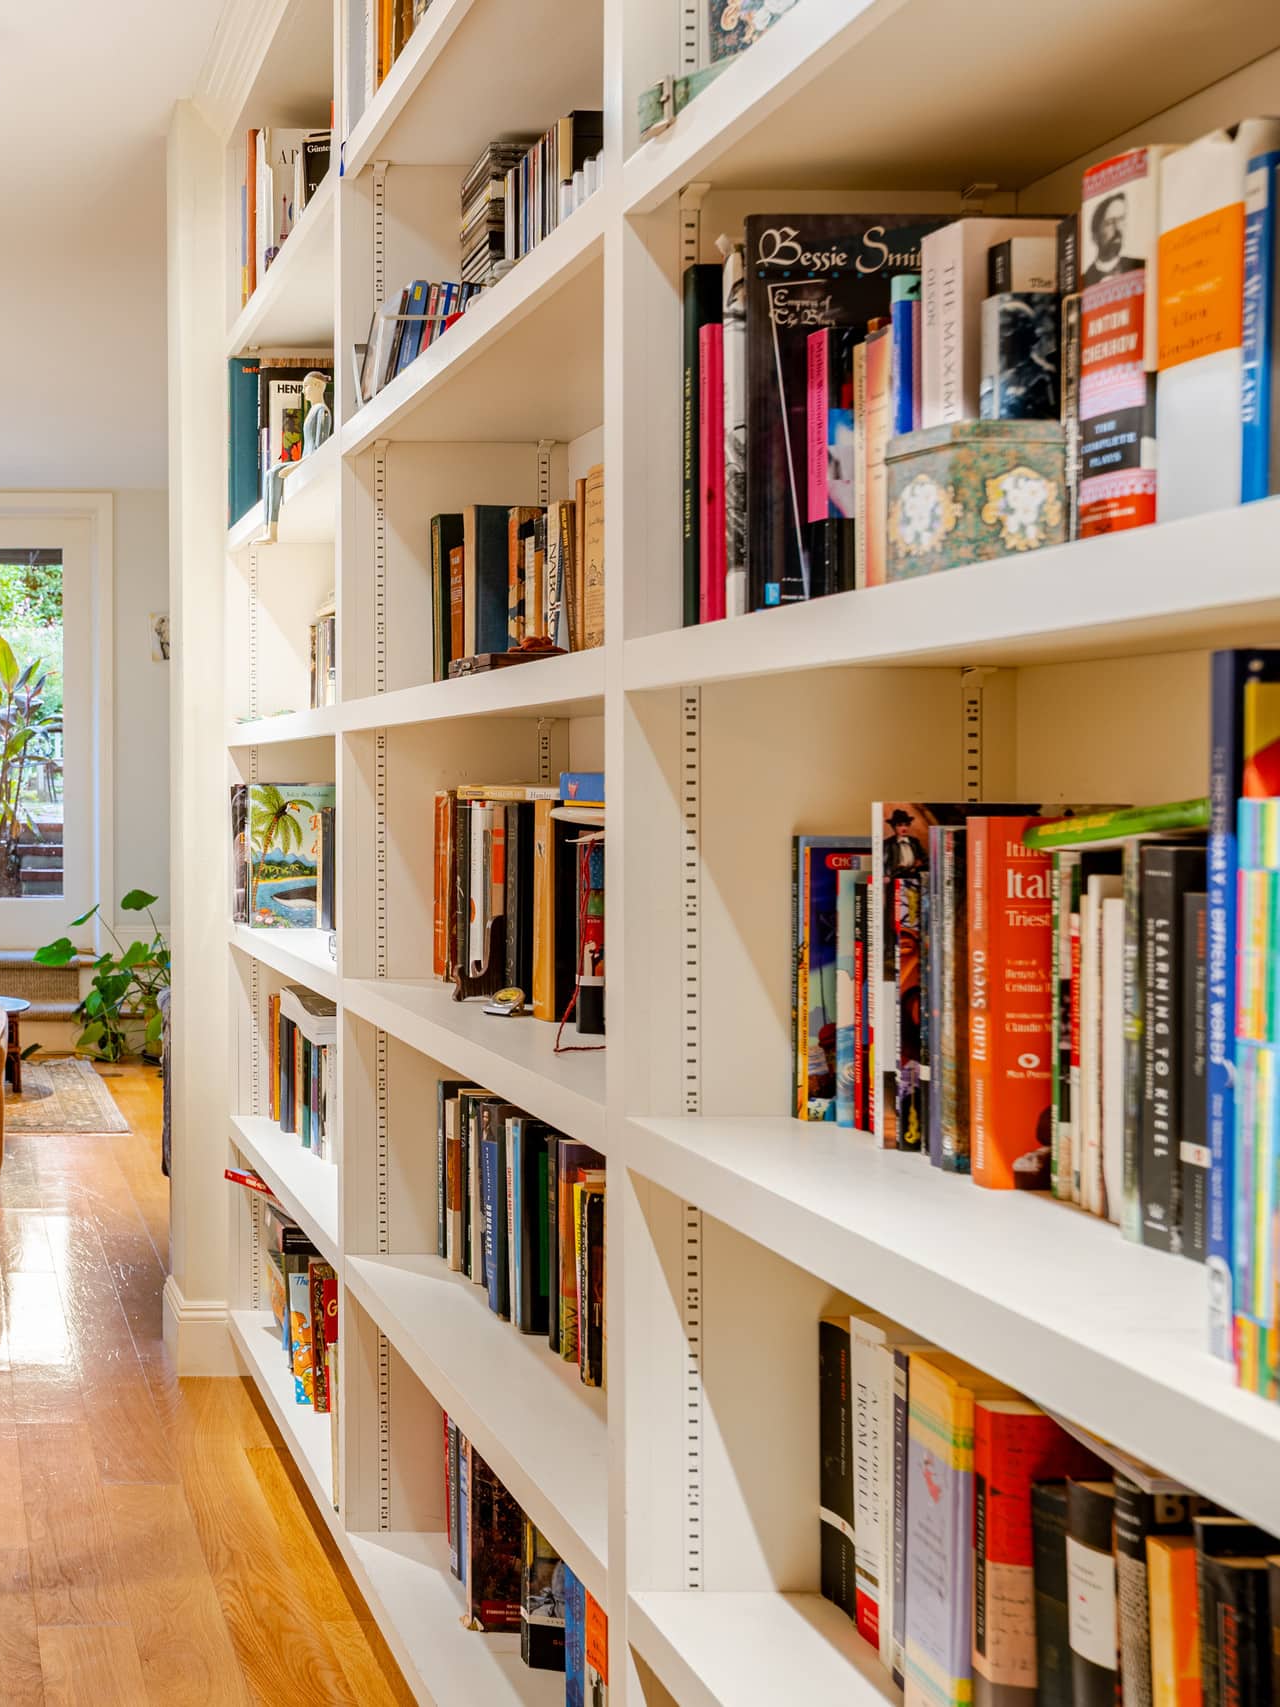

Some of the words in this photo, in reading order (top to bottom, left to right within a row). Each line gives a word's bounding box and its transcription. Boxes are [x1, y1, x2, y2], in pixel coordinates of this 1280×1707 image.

[756, 226, 848, 272] Bessie
[856, 226, 922, 273] Smit
[1244, 223, 1263, 264] THE
[1243, 274, 1262, 349] WASTE
[277, 383, 304, 395] HENR
[1241, 360, 1261, 423] LAND
[548, 543, 558, 640] NABOKO
[1005, 868, 1052, 899] Ital
[1004, 910, 1051, 927] Triest
[972, 950, 986, 1009] Svevo
[1154, 918, 1170, 1036] LEARNING
[972, 1016, 986, 1062] Italo
[1154, 1047, 1168, 1075] TO
[1153, 1087, 1168, 1157] KNEEL
[485, 1203, 493, 1256] DOUGLASS
[293, 1275, 310, 1286] The
[856, 1381, 869, 1448] FROM
[894, 1406, 905, 1433] THE
[894, 1541, 904, 1585] TALES
